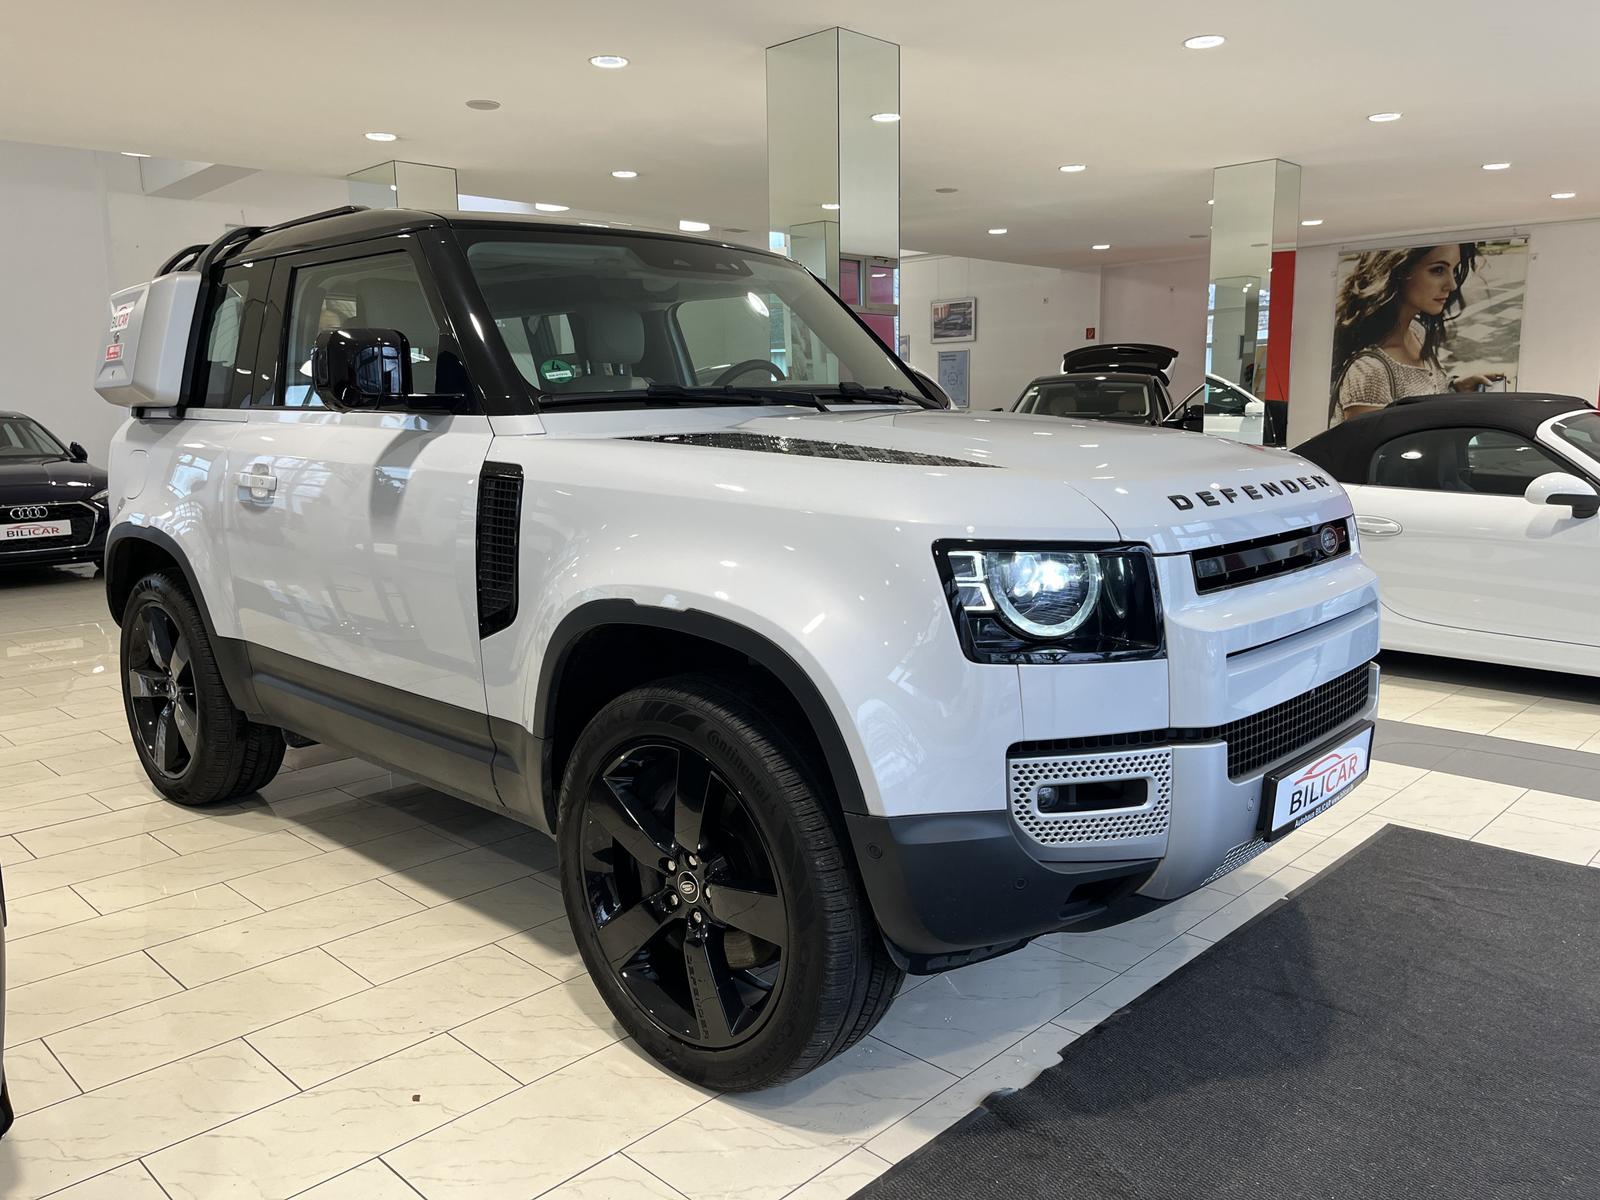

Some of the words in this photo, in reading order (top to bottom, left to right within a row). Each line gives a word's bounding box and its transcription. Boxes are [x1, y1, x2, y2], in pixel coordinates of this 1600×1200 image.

[551, 361, 561, 371] 4
[1167, 475, 1330, 511] DEFENDER
[6, 527, 60, 538] BILICAR
[706, 730, 771, 802] Continental
[1289, 755, 1358, 816] BILICAR
